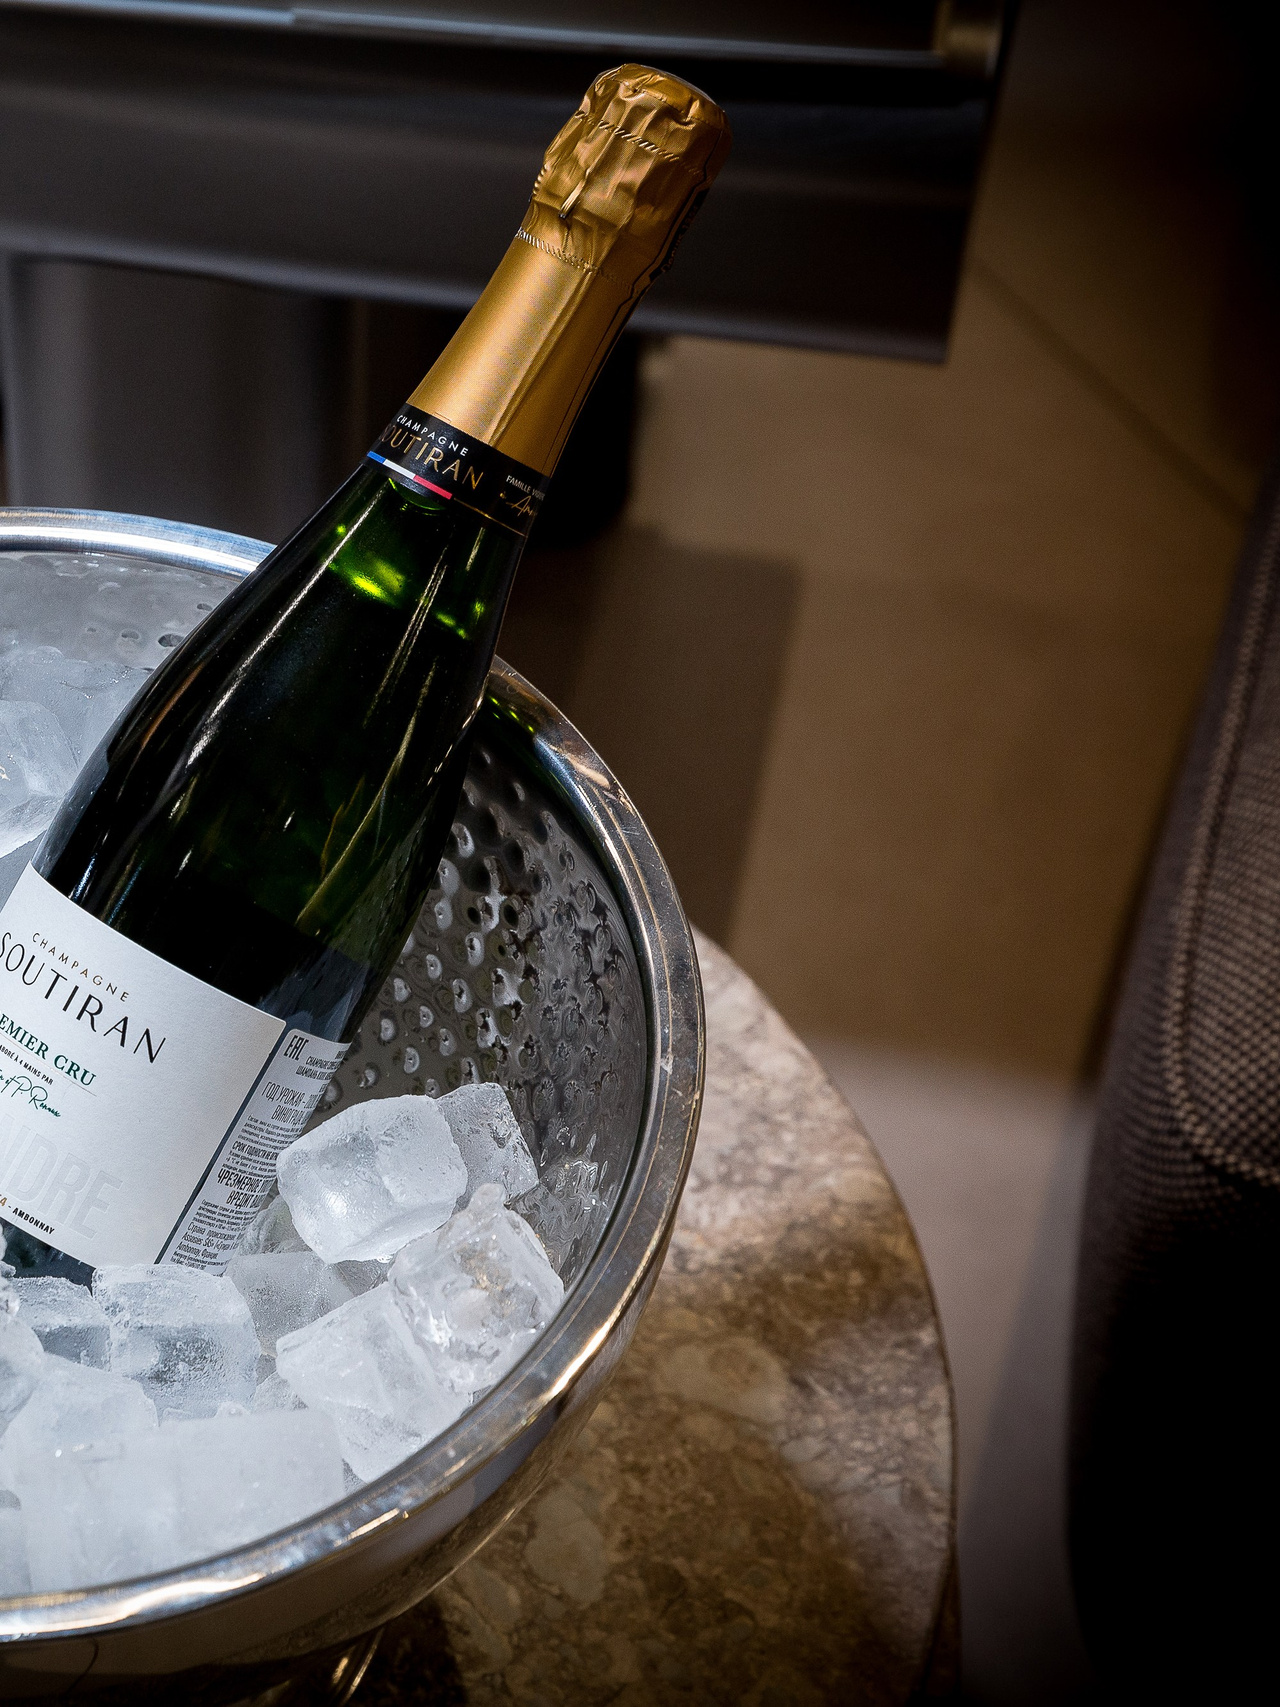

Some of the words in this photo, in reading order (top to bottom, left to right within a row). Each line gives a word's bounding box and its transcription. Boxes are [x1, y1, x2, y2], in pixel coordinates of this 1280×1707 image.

[396, 414, 469, 456] CHAMPAGNE
[380, 423, 484, 490] OUTIRAN
[506, 475, 531, 494] FAMILLE
[31, 932, 130, 1003] CHAMPAGNE
[23, 1062, 42, 1078] MAINS
[41, 1074, 54, 1086] PAR
[53, 1054, 97, 1086] CRU
[261, 1081, 281, 1102] ГОД
[217, 1168, 262, 1193] ЧРЕЗМЕРНОЕ
[12, 1207, 55, 1235] AMBONNAY
